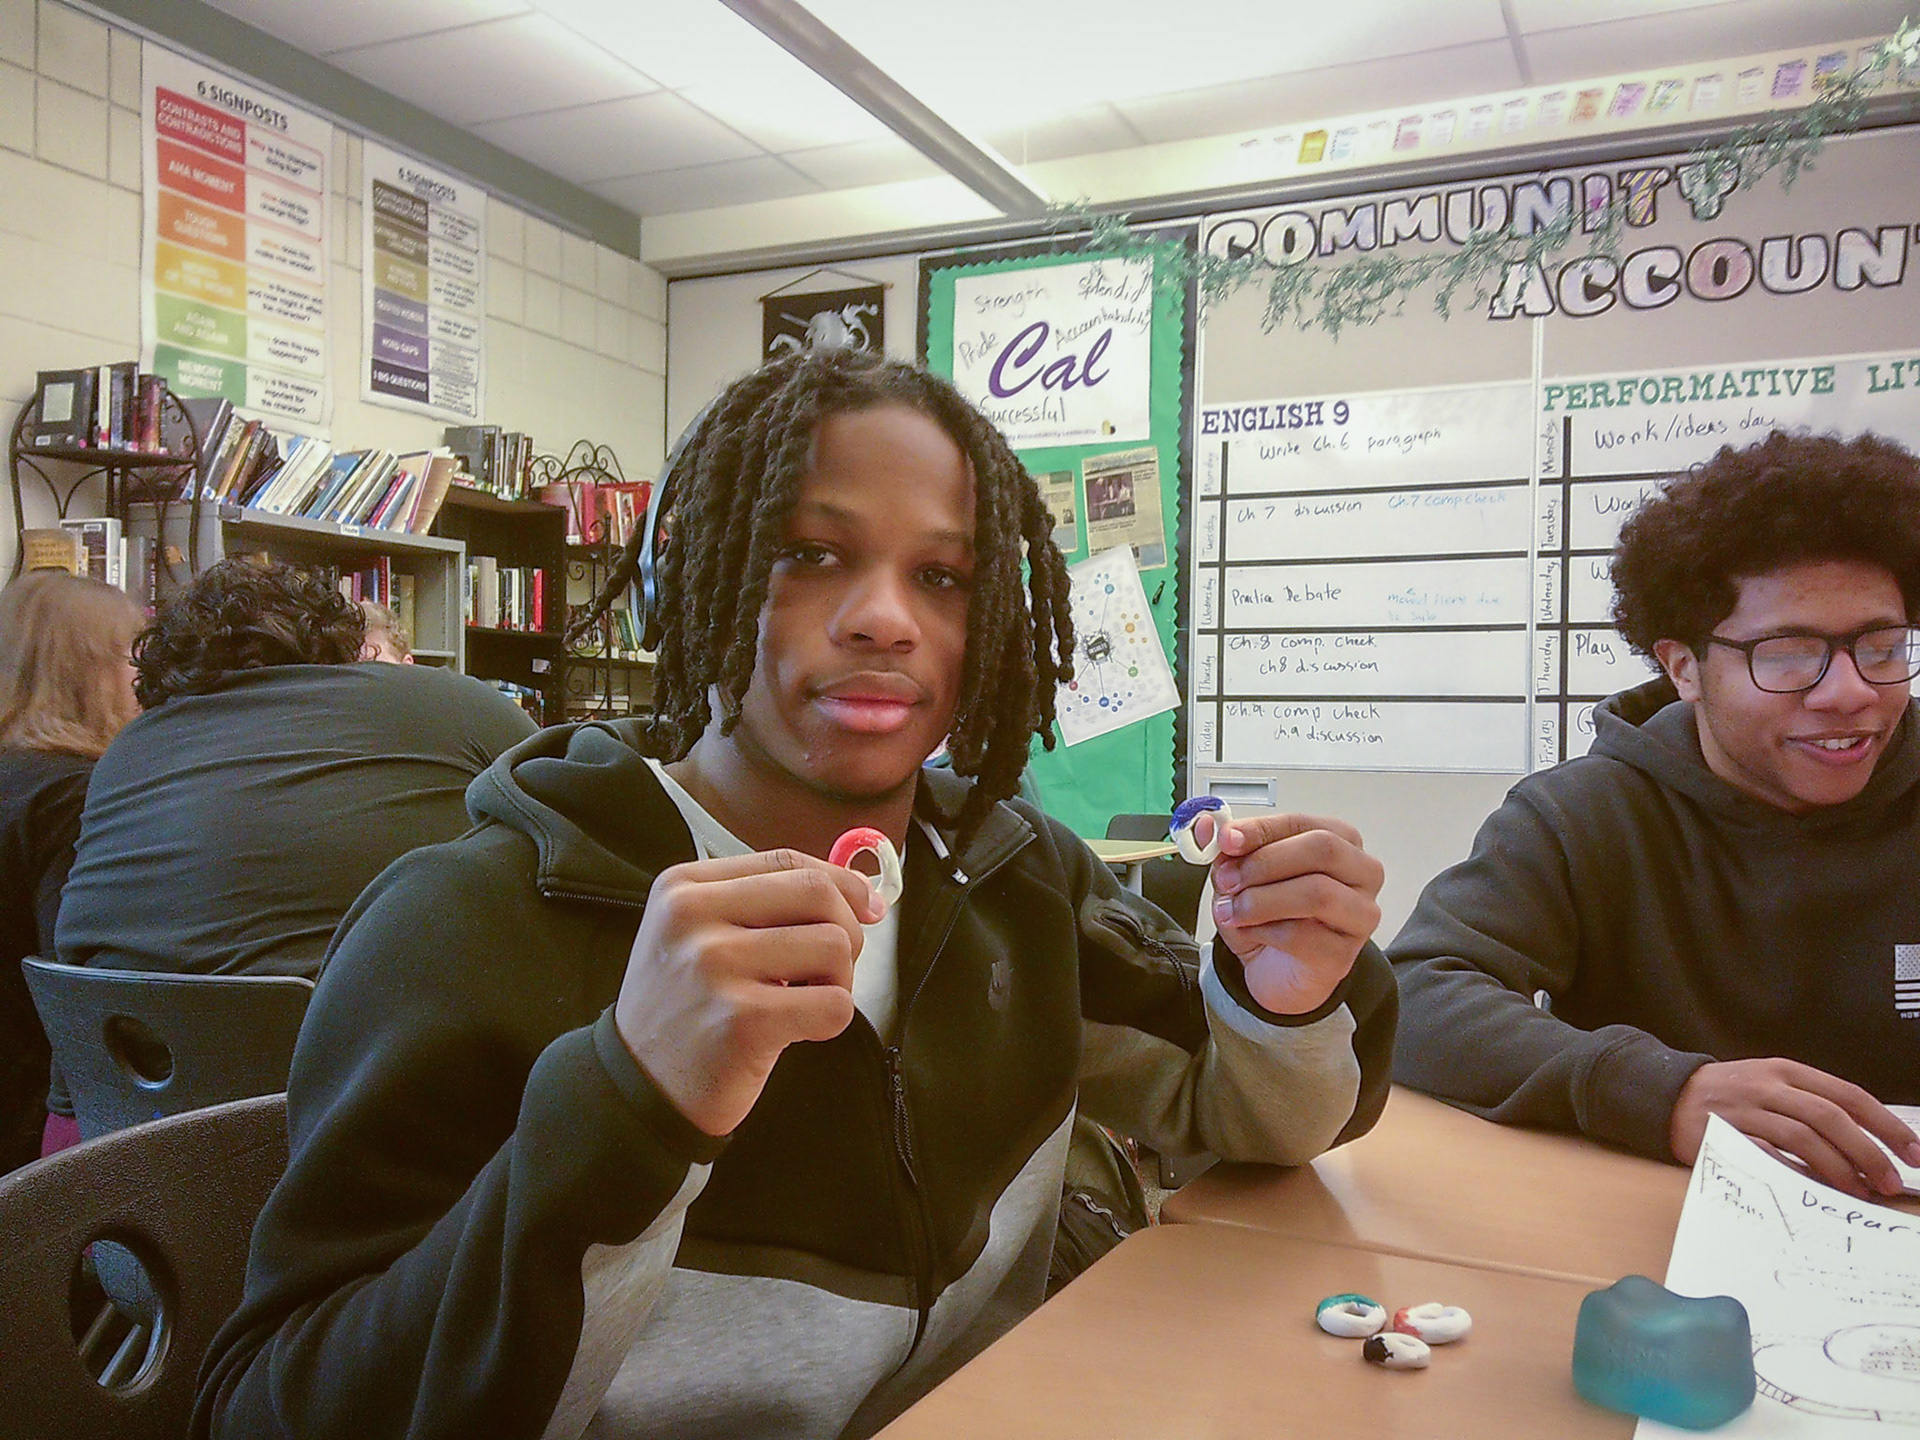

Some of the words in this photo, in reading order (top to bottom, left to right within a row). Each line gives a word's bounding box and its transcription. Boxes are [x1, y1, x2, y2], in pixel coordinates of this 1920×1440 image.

[197, 80, 207, 95] 6
[210, 85, 289, 131] SIGNPOSTS
[1488, 225, 1920, 320] ACCOUN
[1056, 307, 1152, 350] Accountability
[958, 330, 1000, 371] Pride
[988, 320, 1113, 399] Cal
[1543, 365, 1836, 412] PERFORMATIVE
[1201, 401, 1325, 434] ENGLISH
[1333, 400, 1350, 425] 9
[1260, 442, 1301, 461] Write
[1367, 427, 1442, 455] paragraph
[1541, 419, 1560, 475] Monday
[1264, 505, 1276, 520] 7
[1541, 499, 1559, 549] Tuesday
[1283, 582, 1343, 603] Debate
[1539, 560, 1560, 622] Wednesday
[1294, 657, 1380, 674] discussion
[1537, 634, 1559, 695] Thursday
[1575, 631, 1616, 665] Play
[1198, 719, 1214, 753] Friday
[1305, 725, 1384, 744] discussion
[1540, 719, 1555, 764] Friday
[1802, 1190, 1920, 1234] Depar
